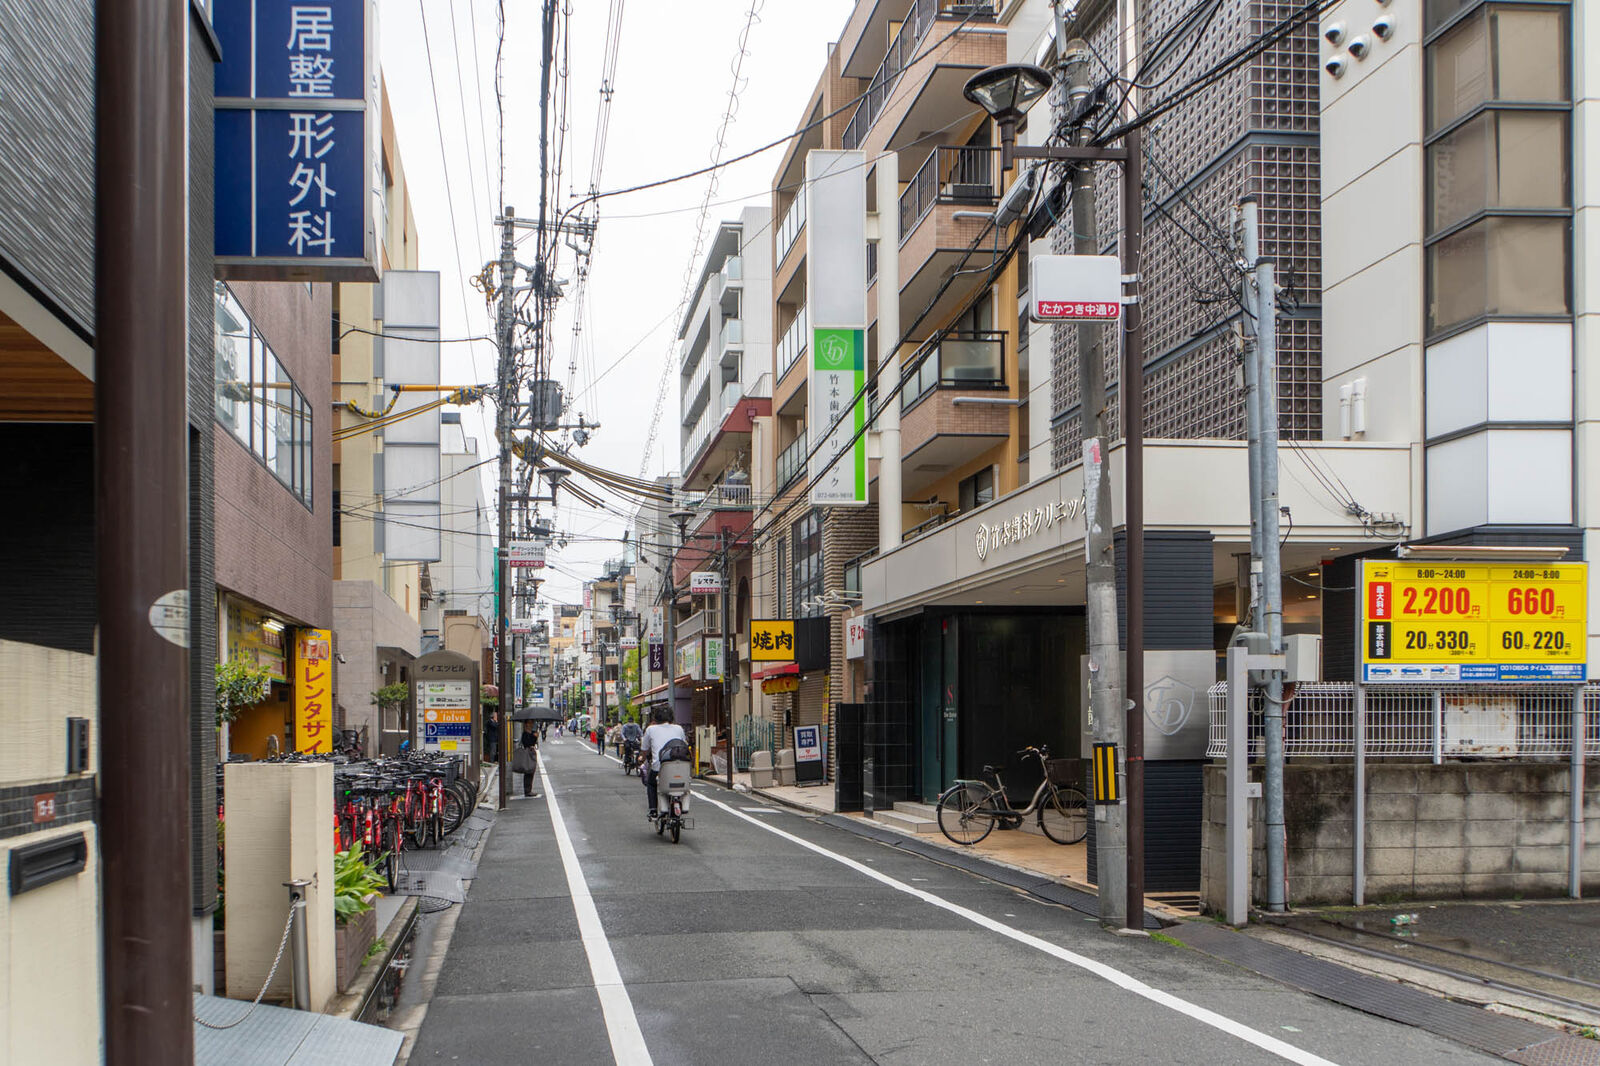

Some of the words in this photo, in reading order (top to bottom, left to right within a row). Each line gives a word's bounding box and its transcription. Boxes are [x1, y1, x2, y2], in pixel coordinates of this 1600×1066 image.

[1041, 303, 1117, 315] たかつき中通り
[752, 630, 793, 650] 焼肉
